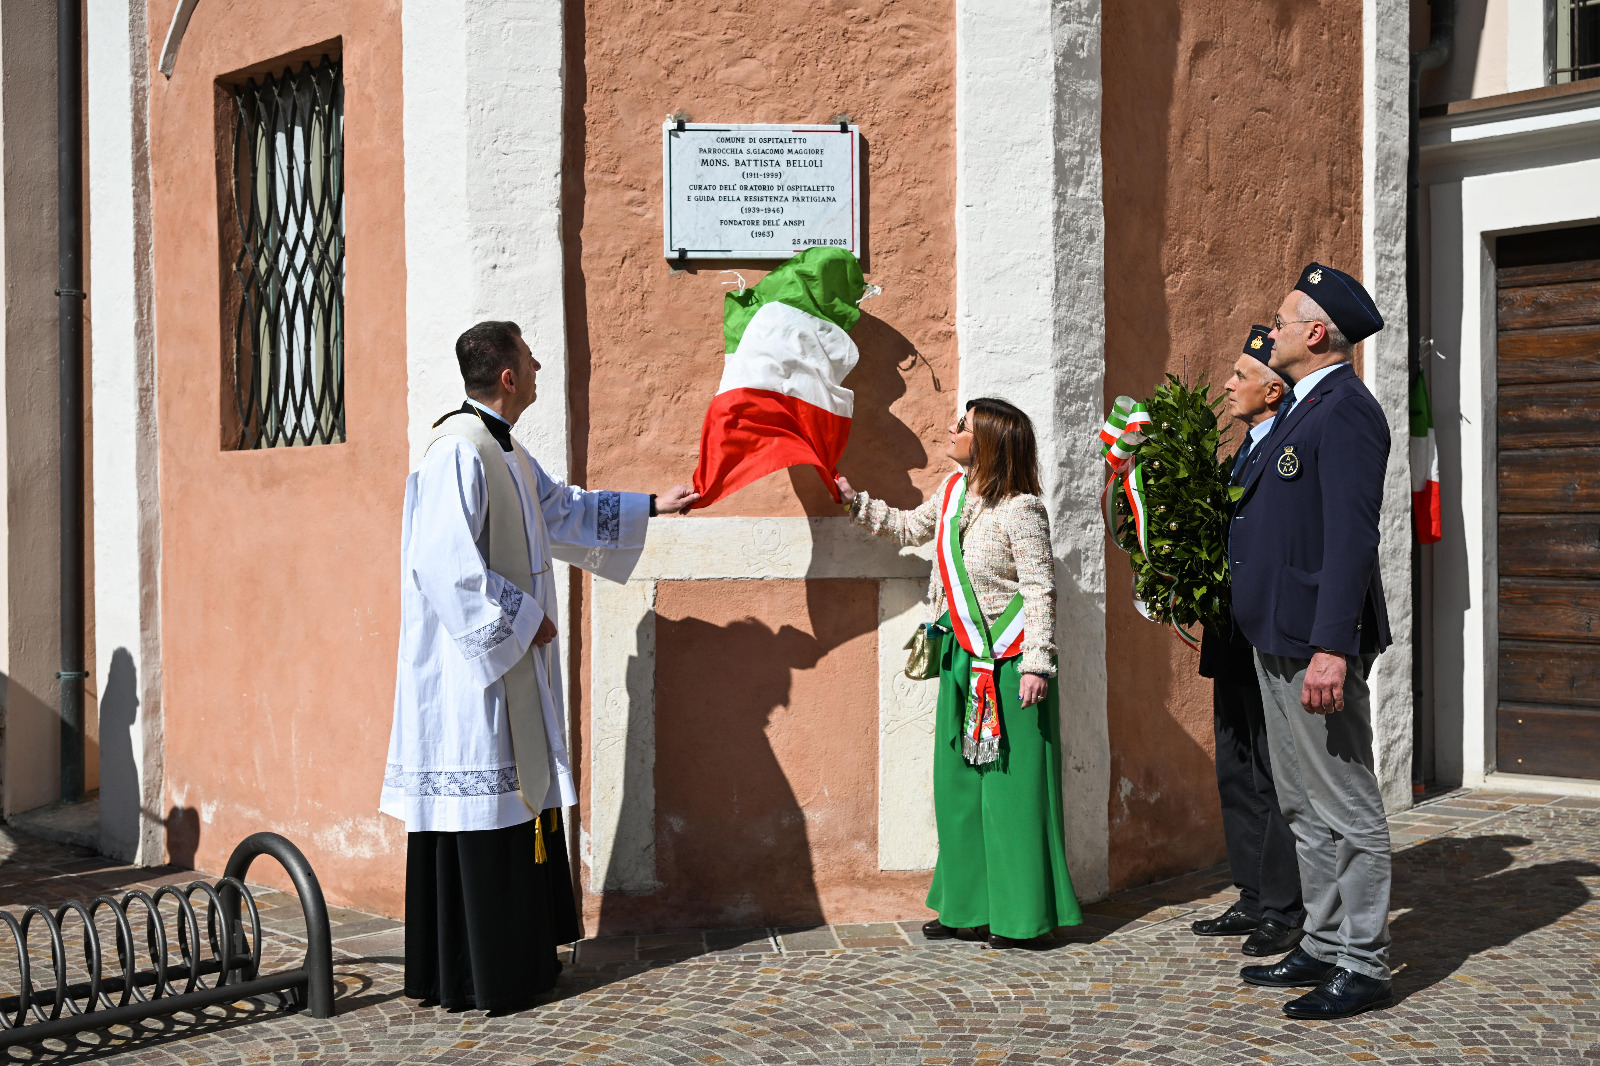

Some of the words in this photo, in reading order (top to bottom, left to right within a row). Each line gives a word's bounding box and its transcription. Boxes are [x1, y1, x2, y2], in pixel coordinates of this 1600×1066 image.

[701, 159, 730, 167] MONS.
[735, 159, 781, 167] BATTISTA
[742, 172, 782, 180] (1911-1999)
